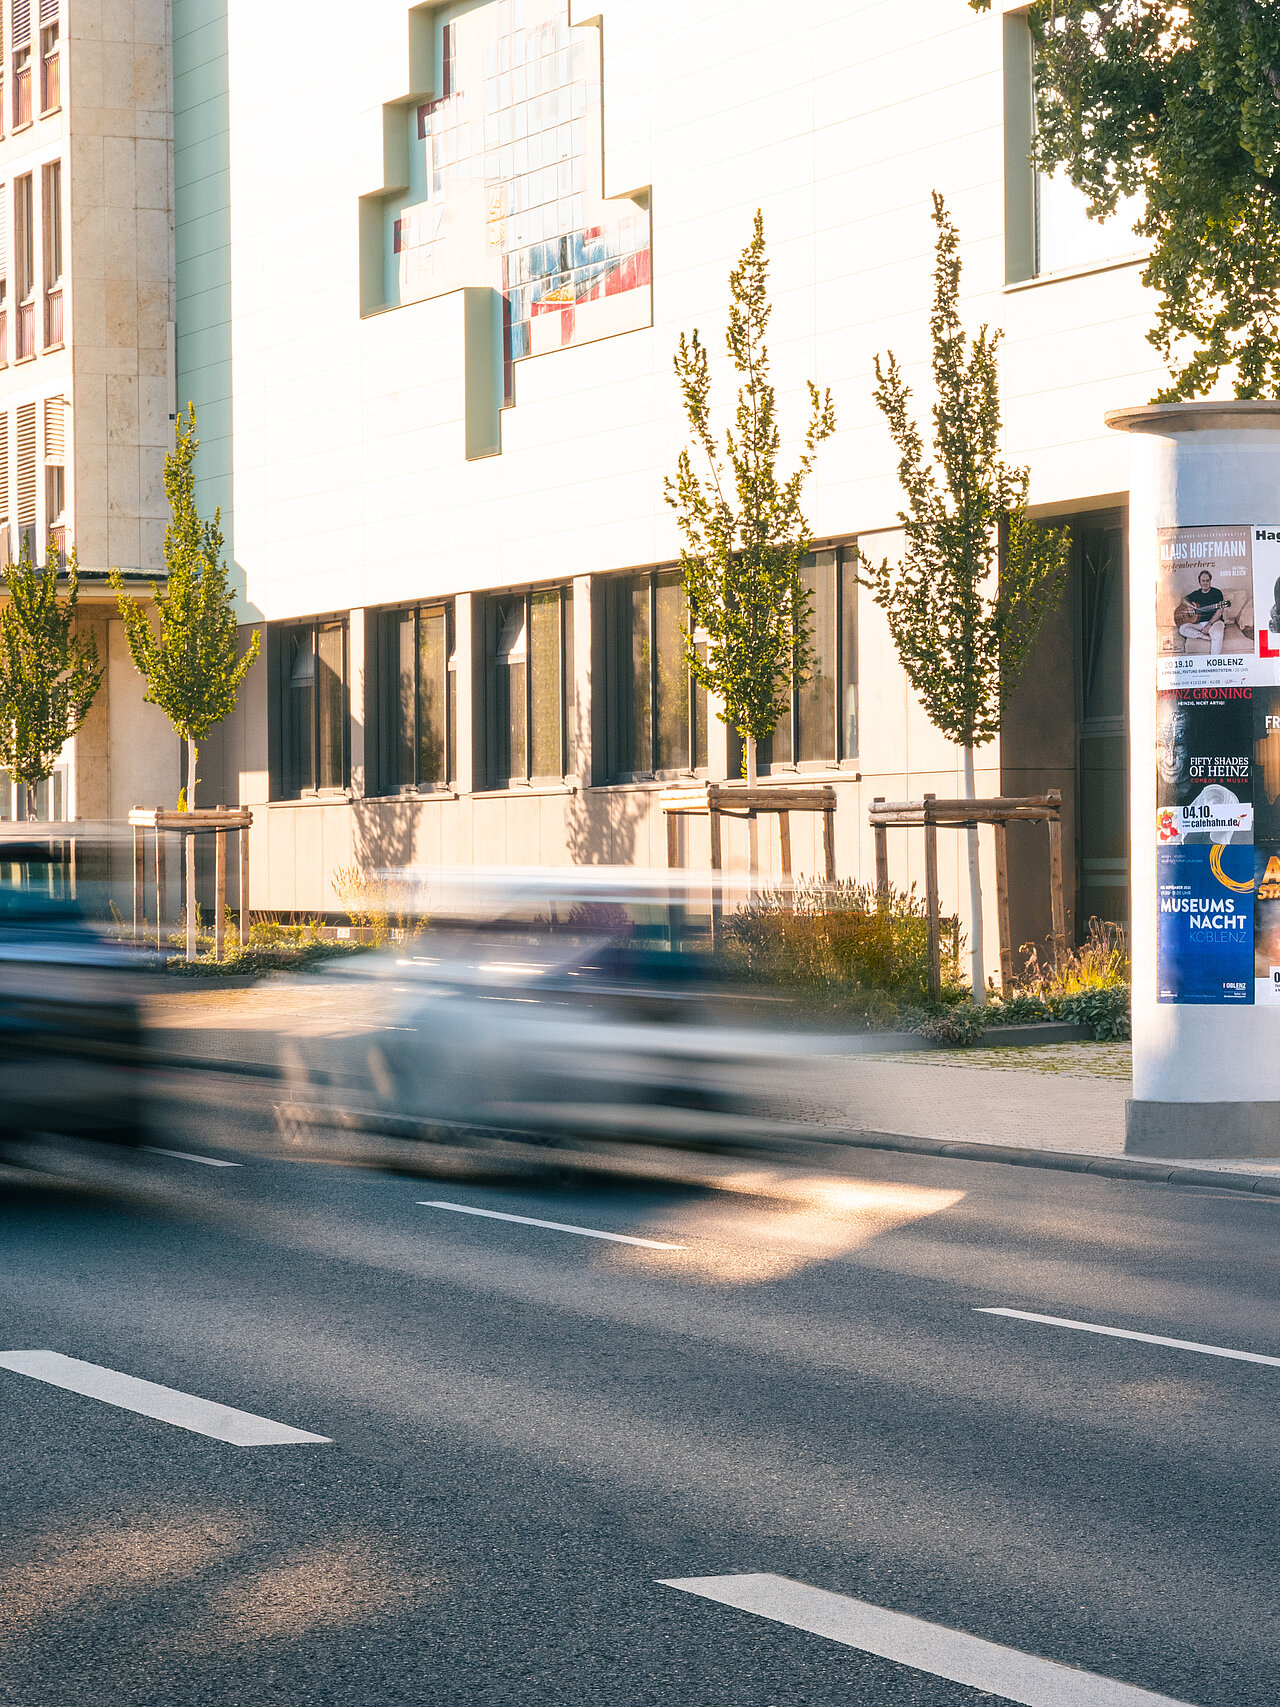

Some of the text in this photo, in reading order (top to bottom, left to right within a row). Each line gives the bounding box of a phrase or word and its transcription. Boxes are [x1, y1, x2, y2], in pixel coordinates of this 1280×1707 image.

[1160, 540, 1246, 561] KLAUS HOFFMANN
[1174, 659, 1194, 669] 19.10
[1206, 658, 1244, 667] KOBLENZ
[1190, 757, 1249, 766] FIFTY SHADES
[1189, 765, 1249, 777] OF HEINZ
[1182, 806, 1213, 819] 04.10.
[1191, 818, 1238, 828] cafehahn.de
[1160, 898, 1234, 913] MUSEUMS
[1189, 914, 1247, 930] NACHT
[1189, 931, 1247, 943] KOBLENZ
